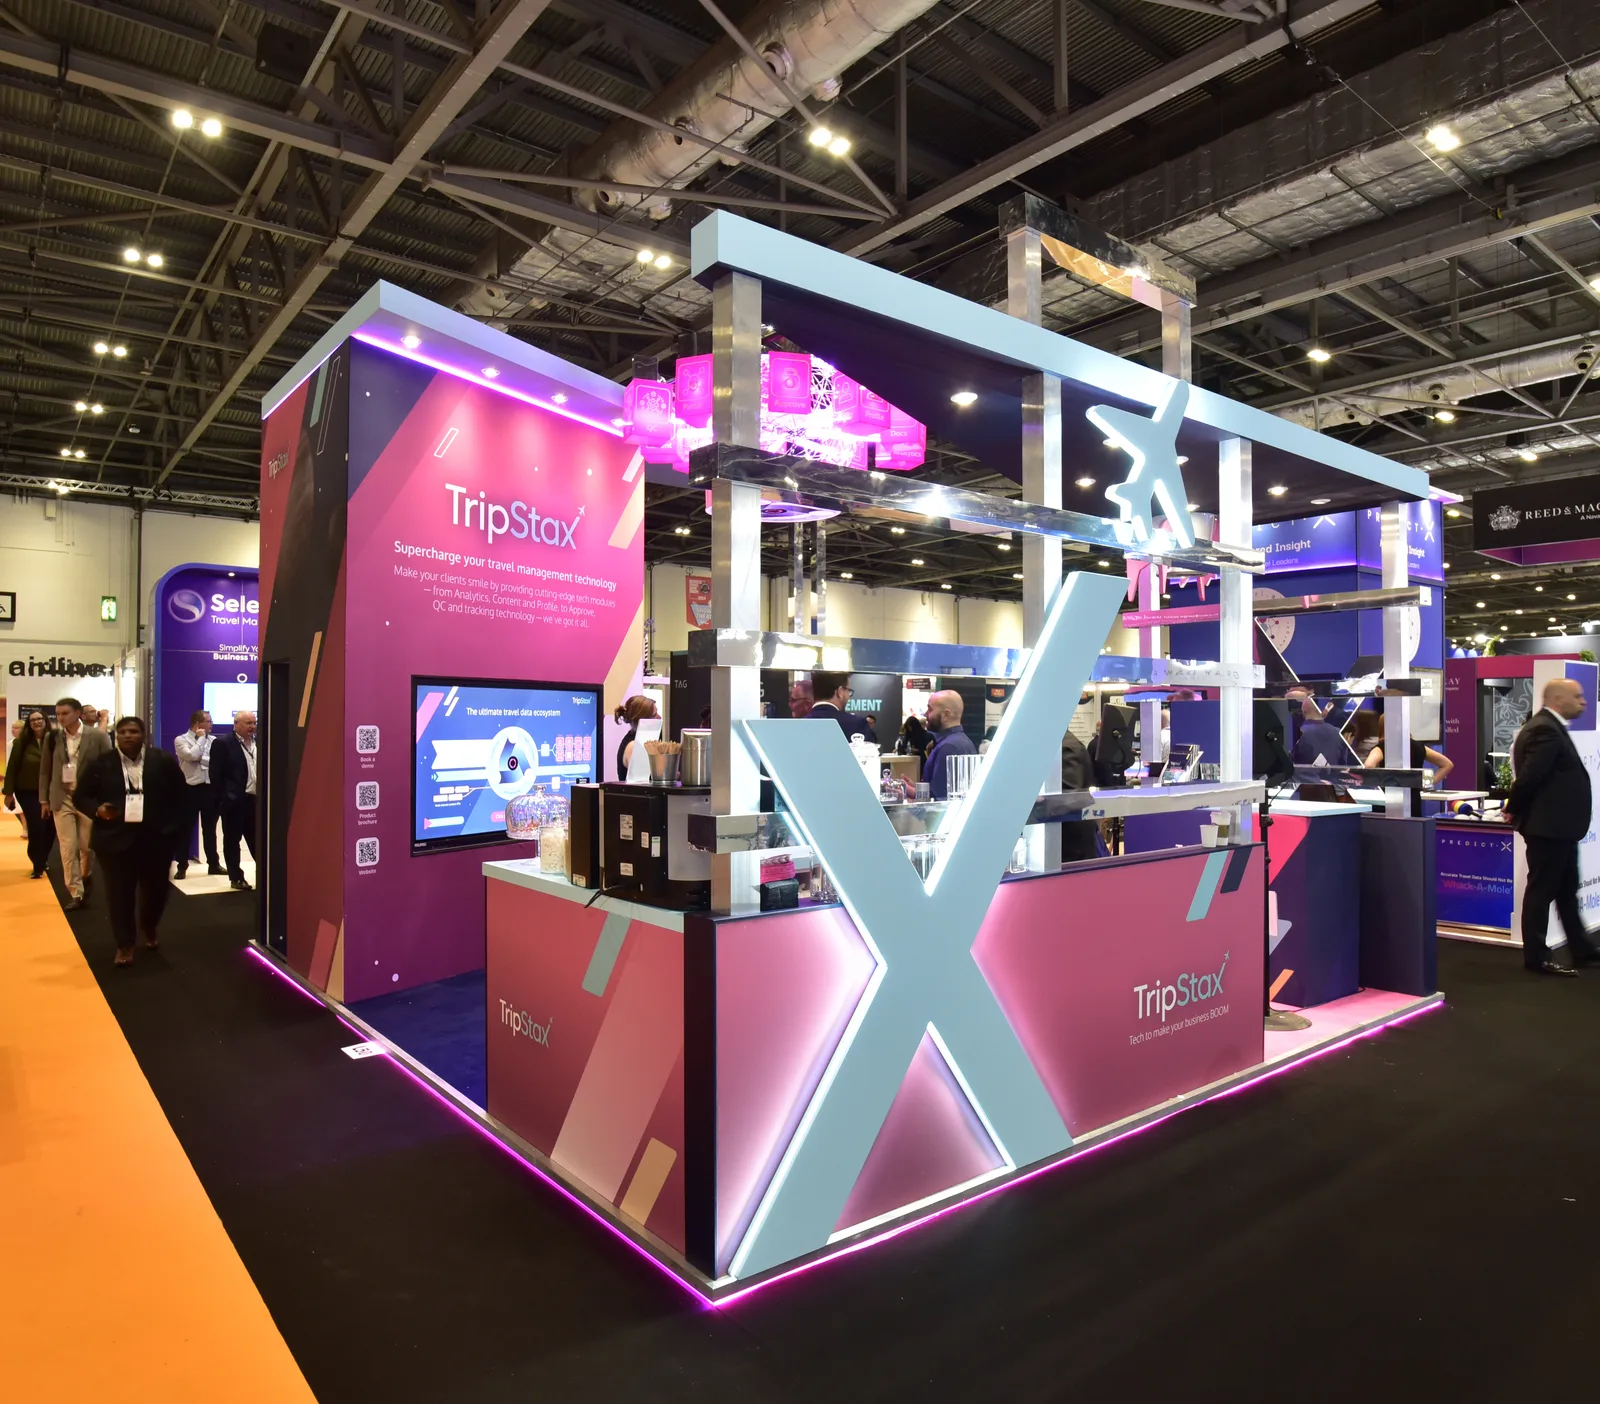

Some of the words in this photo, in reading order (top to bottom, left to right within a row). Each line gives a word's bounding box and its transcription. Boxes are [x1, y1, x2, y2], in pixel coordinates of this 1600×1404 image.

[445, 483, 580, 549] TripStax
[1525, 506, 1562, 519] REED
[1564, 506, 1572, 515] &
[1275, 540, 1311, 552] Insight
[394, 540, 461, 566] Supercharge
[463, 555, 486, 568] your
[488, 558, 516, 573] travel
[517, 564, 573, 583] management
[574, 573, 617, 592] technology
[1272, 558, 1299, 566] Leaders
[394, 565, 419, 578] Make
[420, 571, 439, 582] your
[440, 572, 467, 586] clients
[468, 578, 489, 588] smile
[490, 579, 500, 592] by
[500, 583, 534, 597] providing
[535, 588, 576, 603] cutting-edge
[576, 594, 590, 604] tech
[590, 597, 616, 608] modules
[433, 585, 453, 597] from
[454, 588, 491, 603] Analytics,
[492, 594, 521, 607] Content
[522, 599, 536, 609] and
[536, 600, 560, 612] Profile,
[560, 604, 568, 613] to
[569, 605, 596, 617] Approve,
[432, 600, 447, 612] QC
[448, 603, 463, 613] and
[464, 605, 495, 619] tracking
[495, 608, 536, 624] technology
[563, 618, 574, 627] got
[574, 618, 580, 627] it
[211, 615, 240, 625] Travel
[219, 644, 250, 652] Simplify
[213, 653, 249, 661] Business
[674, 680, 688, 689] TAG
[845, 699, 882, 711] EMENT
[466, 707, 478, 716] The
[478, 707, 503, 716] ultimate
[503, 708, 520, 717] travel
[520, 709, 533, 717] data
[533, 709, 561, 718] ecosystem
[357, 818, 378, 826] brochure
[358, 868, 377, 876] Website
[1133, 962, 1226, 1022] TripStax
[499, 998, 551, 1048] TripStax
[1129, 1034, 1145, 1045] Tech
[1145, 1031, 1153, 1040] to
[1152, 1025, 1170, 1038] make
[1170, 1020, 1185, 1035] your
[1184, 1011, 1210, 1027] business
[1210, 1003, 1230, 1019] BOOM
